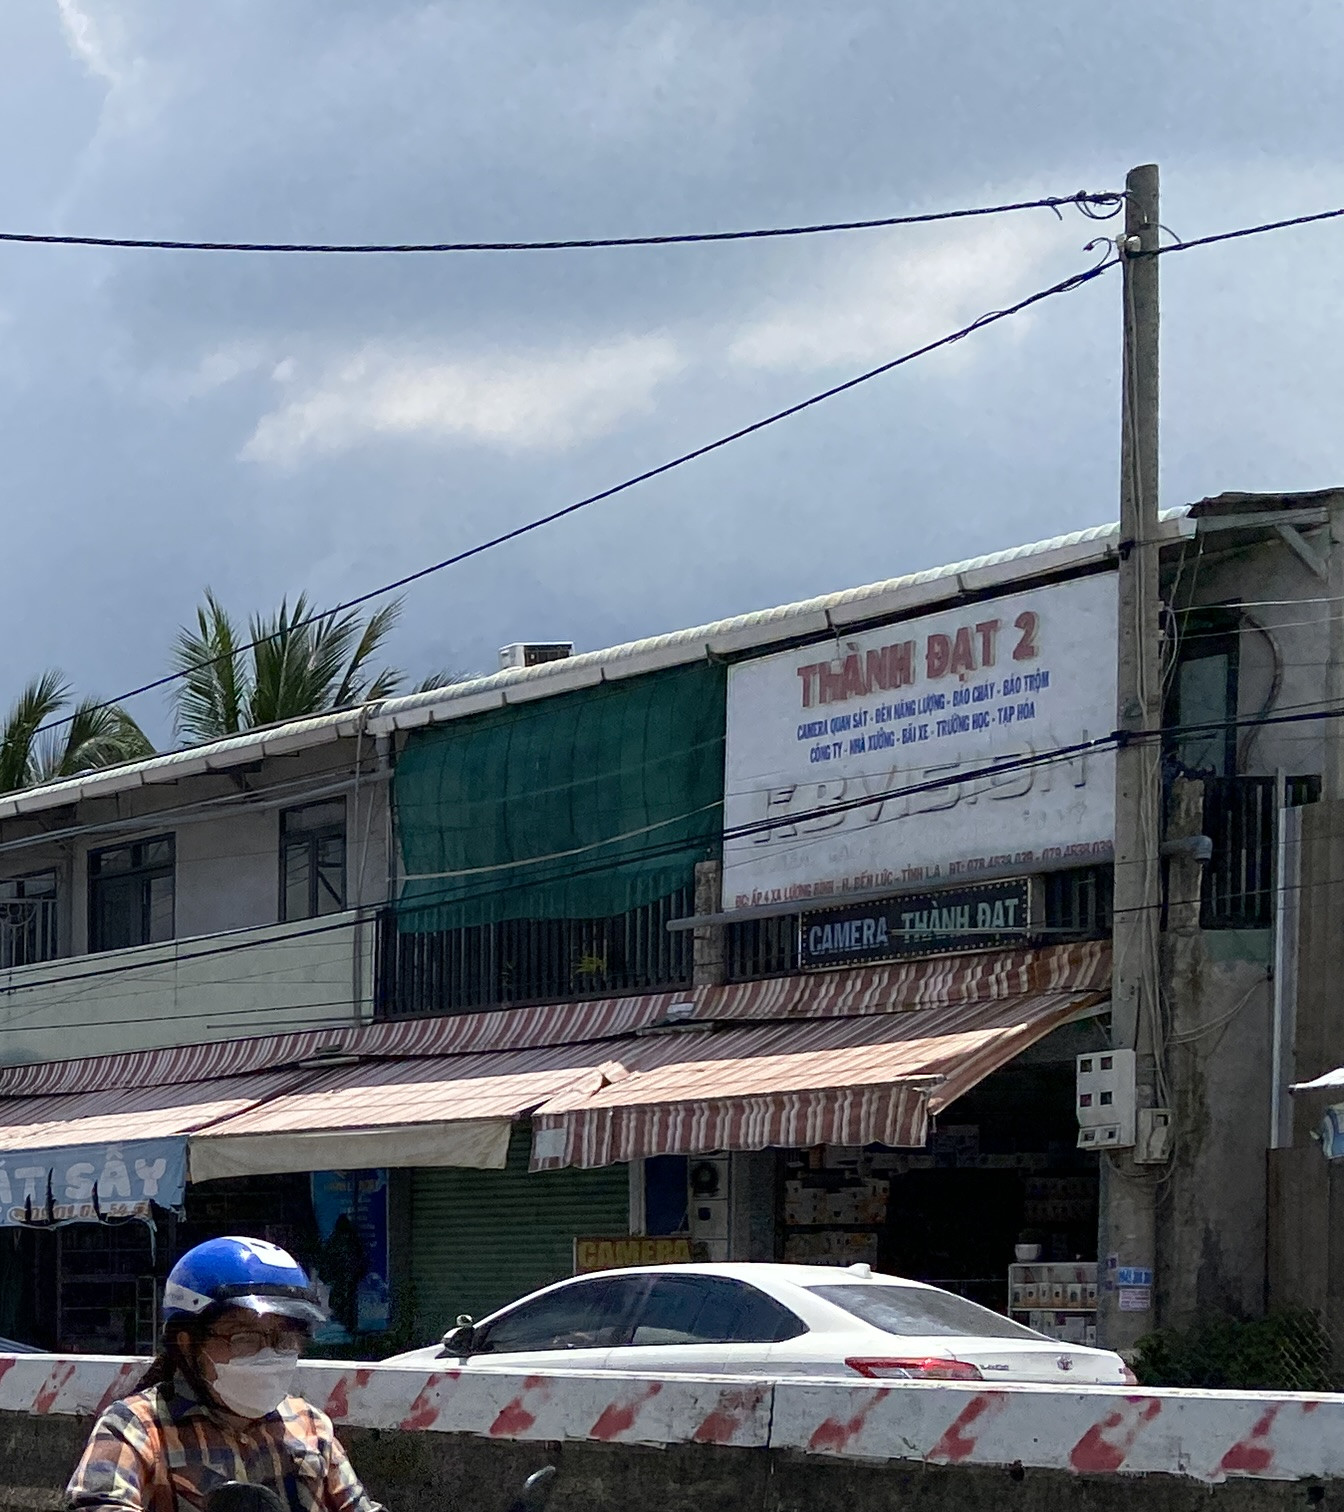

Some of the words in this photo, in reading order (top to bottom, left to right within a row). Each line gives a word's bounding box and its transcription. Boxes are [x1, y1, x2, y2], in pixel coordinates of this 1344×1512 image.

[797, 642, 916, 708] THÀNH
[925, 620, 1001, 682] ĐẠT
[1013, 611, 1038, 661] 2
[797, 718, 828, 741] CAMERA
[830, 714, 852, 734] QUAN
[853, 706, 869, 729] SÁT
[952, 687, 971, 707] BÁO
[1002, 675, 1023, 697] BÁO
[809, 742, 832, 764] CÔNG
[832, 741, 845, 760] TY
[849, 735, 867, 757] NHÀ
[918, 724, 930, 743] XE
[972, 710, 991, 731] HỌC
[1016, 700, 1036, 721] HÓA
[810, 917, 888, 953] CAMERA
[902, 900, 970, 942] THÀNH
